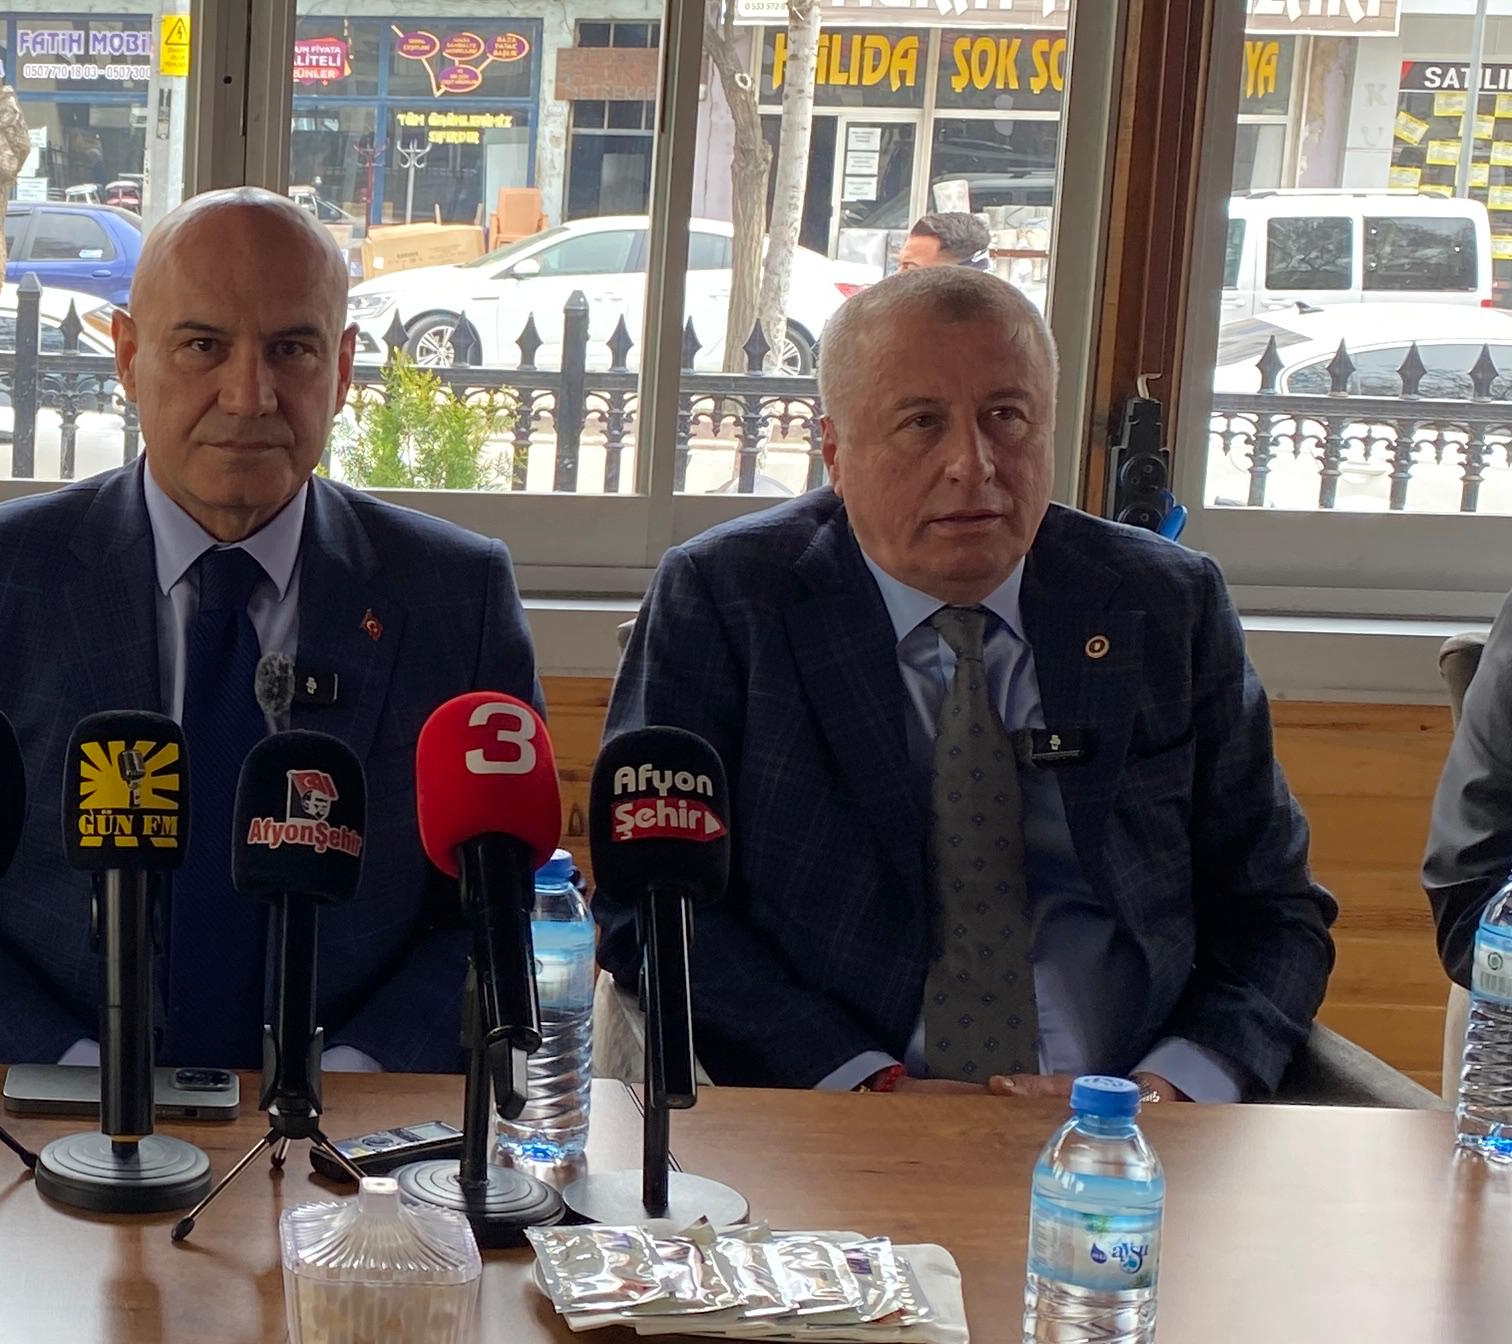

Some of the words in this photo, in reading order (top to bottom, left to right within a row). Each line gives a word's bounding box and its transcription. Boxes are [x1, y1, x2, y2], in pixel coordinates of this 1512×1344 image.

[951, 37, 1021, 92] ŞOK
[465, 702, 537, 774] 3
[614, 764, 713, 797] Afyon
[144, 815, 178, 836] FM
[615, 801, 700, 840] Şehir
